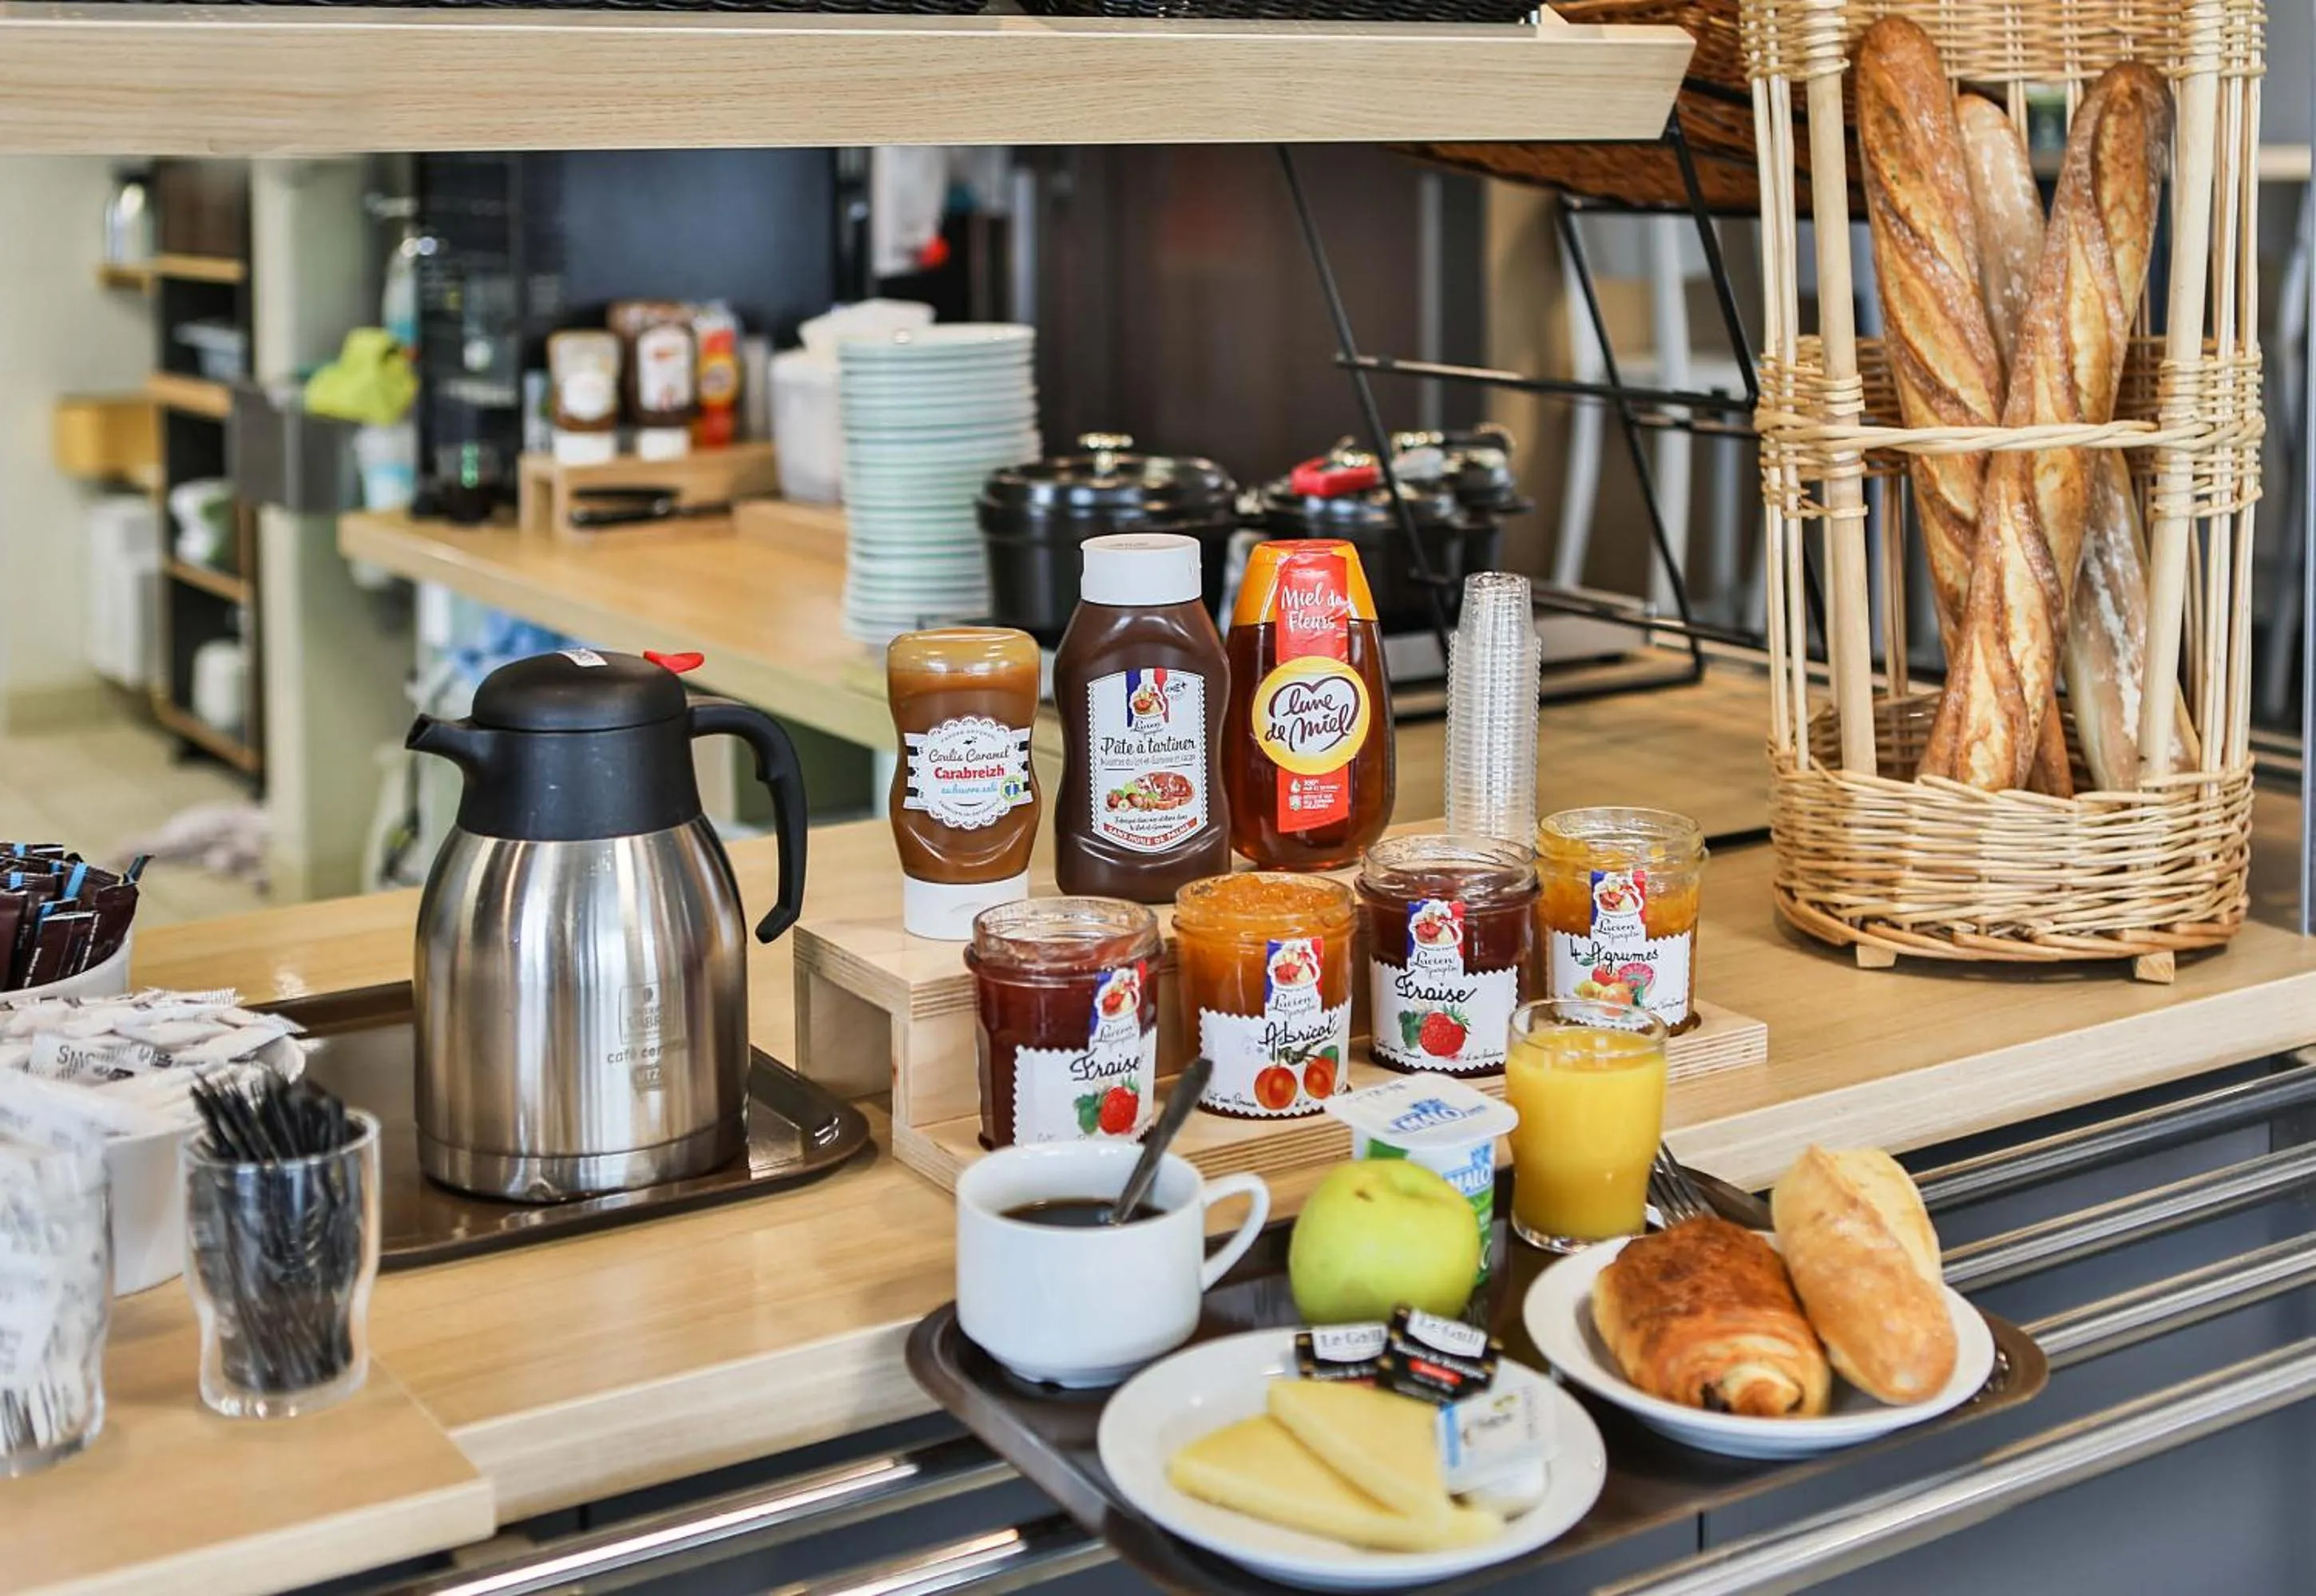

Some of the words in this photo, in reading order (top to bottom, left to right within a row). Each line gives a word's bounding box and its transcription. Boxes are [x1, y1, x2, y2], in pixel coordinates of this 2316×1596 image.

[1281, 582, 1322, 610] Miel
[1287, 610, 1336, 632] Fleurs
[1283, 688, 1338, 715] lune
[1265, 722, 1286, 742] de
[929, 747, 963, 763] Coulis
[966, 745, 1010, 763] Caramel
[1100, 737, 1133, 755] Pâte
[1136, 740, 1146, 754] à
[1148, 736, 1196, 754] tartiner
[934, 764, 1005, 779] Carabreizh
[1154, 836, 1166, 845] DE
[1569, 938, 1582, 961] 4
[1585, 941, 1660, 975] Agrumes
[1395, 969, 1477, 1003] Fraise
[1258, 1012, 1339, 1062] Abricot
[1069, 1047, 1143, 1081] Fraise
